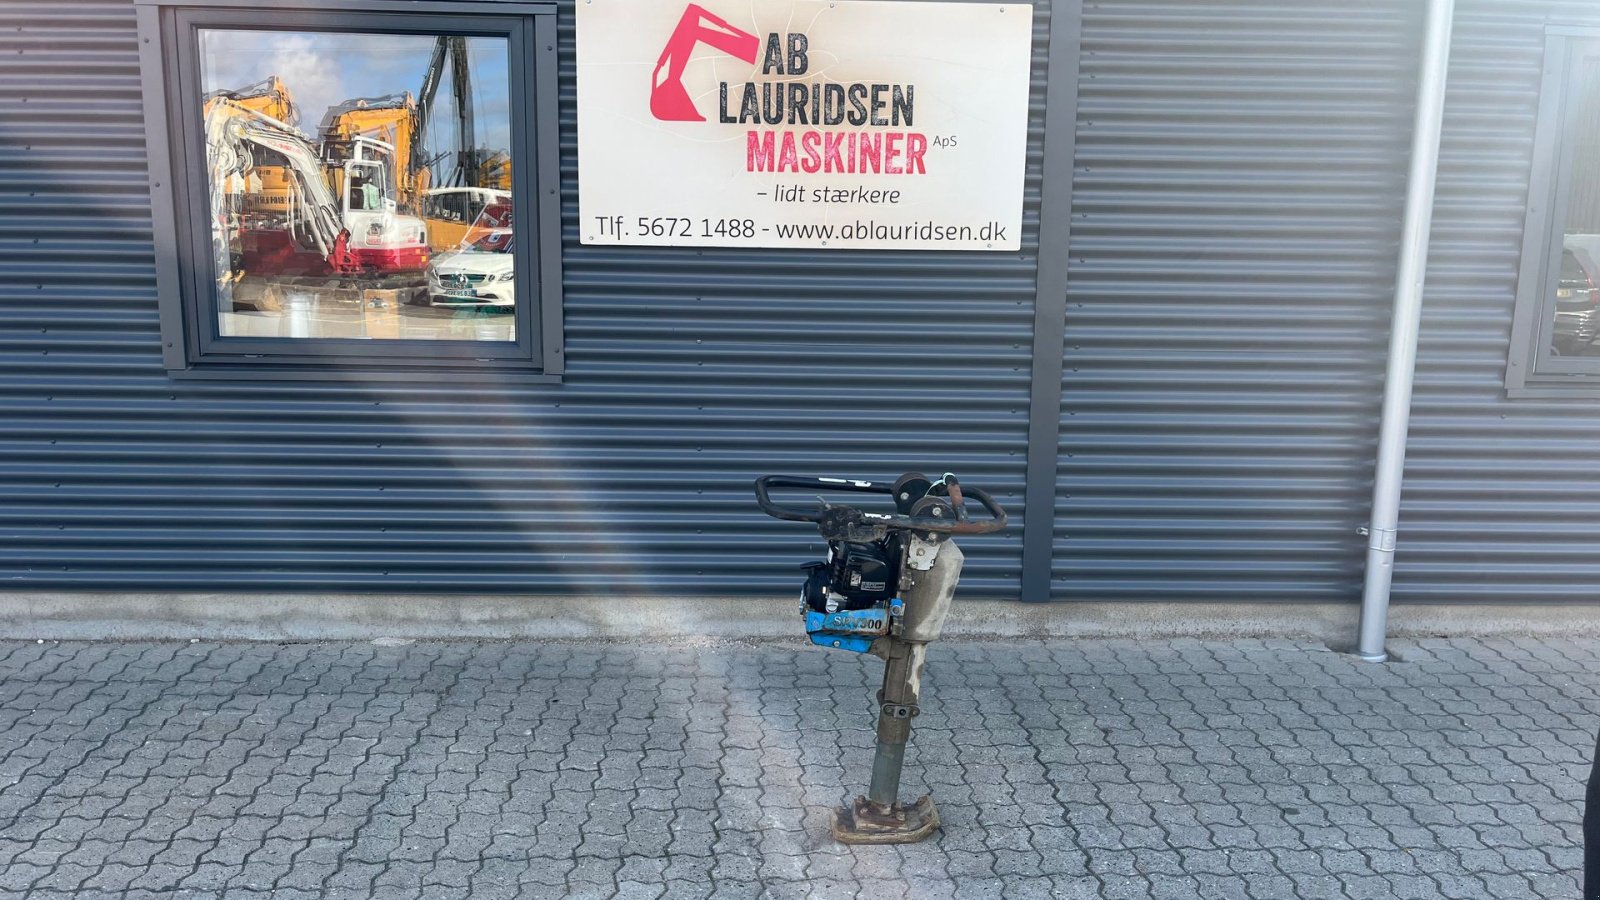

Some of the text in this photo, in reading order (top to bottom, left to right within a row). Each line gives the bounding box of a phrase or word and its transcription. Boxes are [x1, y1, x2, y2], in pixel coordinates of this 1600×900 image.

[762, 32, 809, 76] AB
[719, 81, 914, 127] LAURIDSEN
[747, 130, 957, 175] MASKINER ApS
[774, 184, 806, 203] lidt
[812, 186, 901, 204] stærkere
[595, 215, 629, 240] Tlf.
[638, 217, 692, 237] 5672
[701, 218, 755, 239] 1488
[776, 220, 1007, 241] www.ablauridsen.dk
